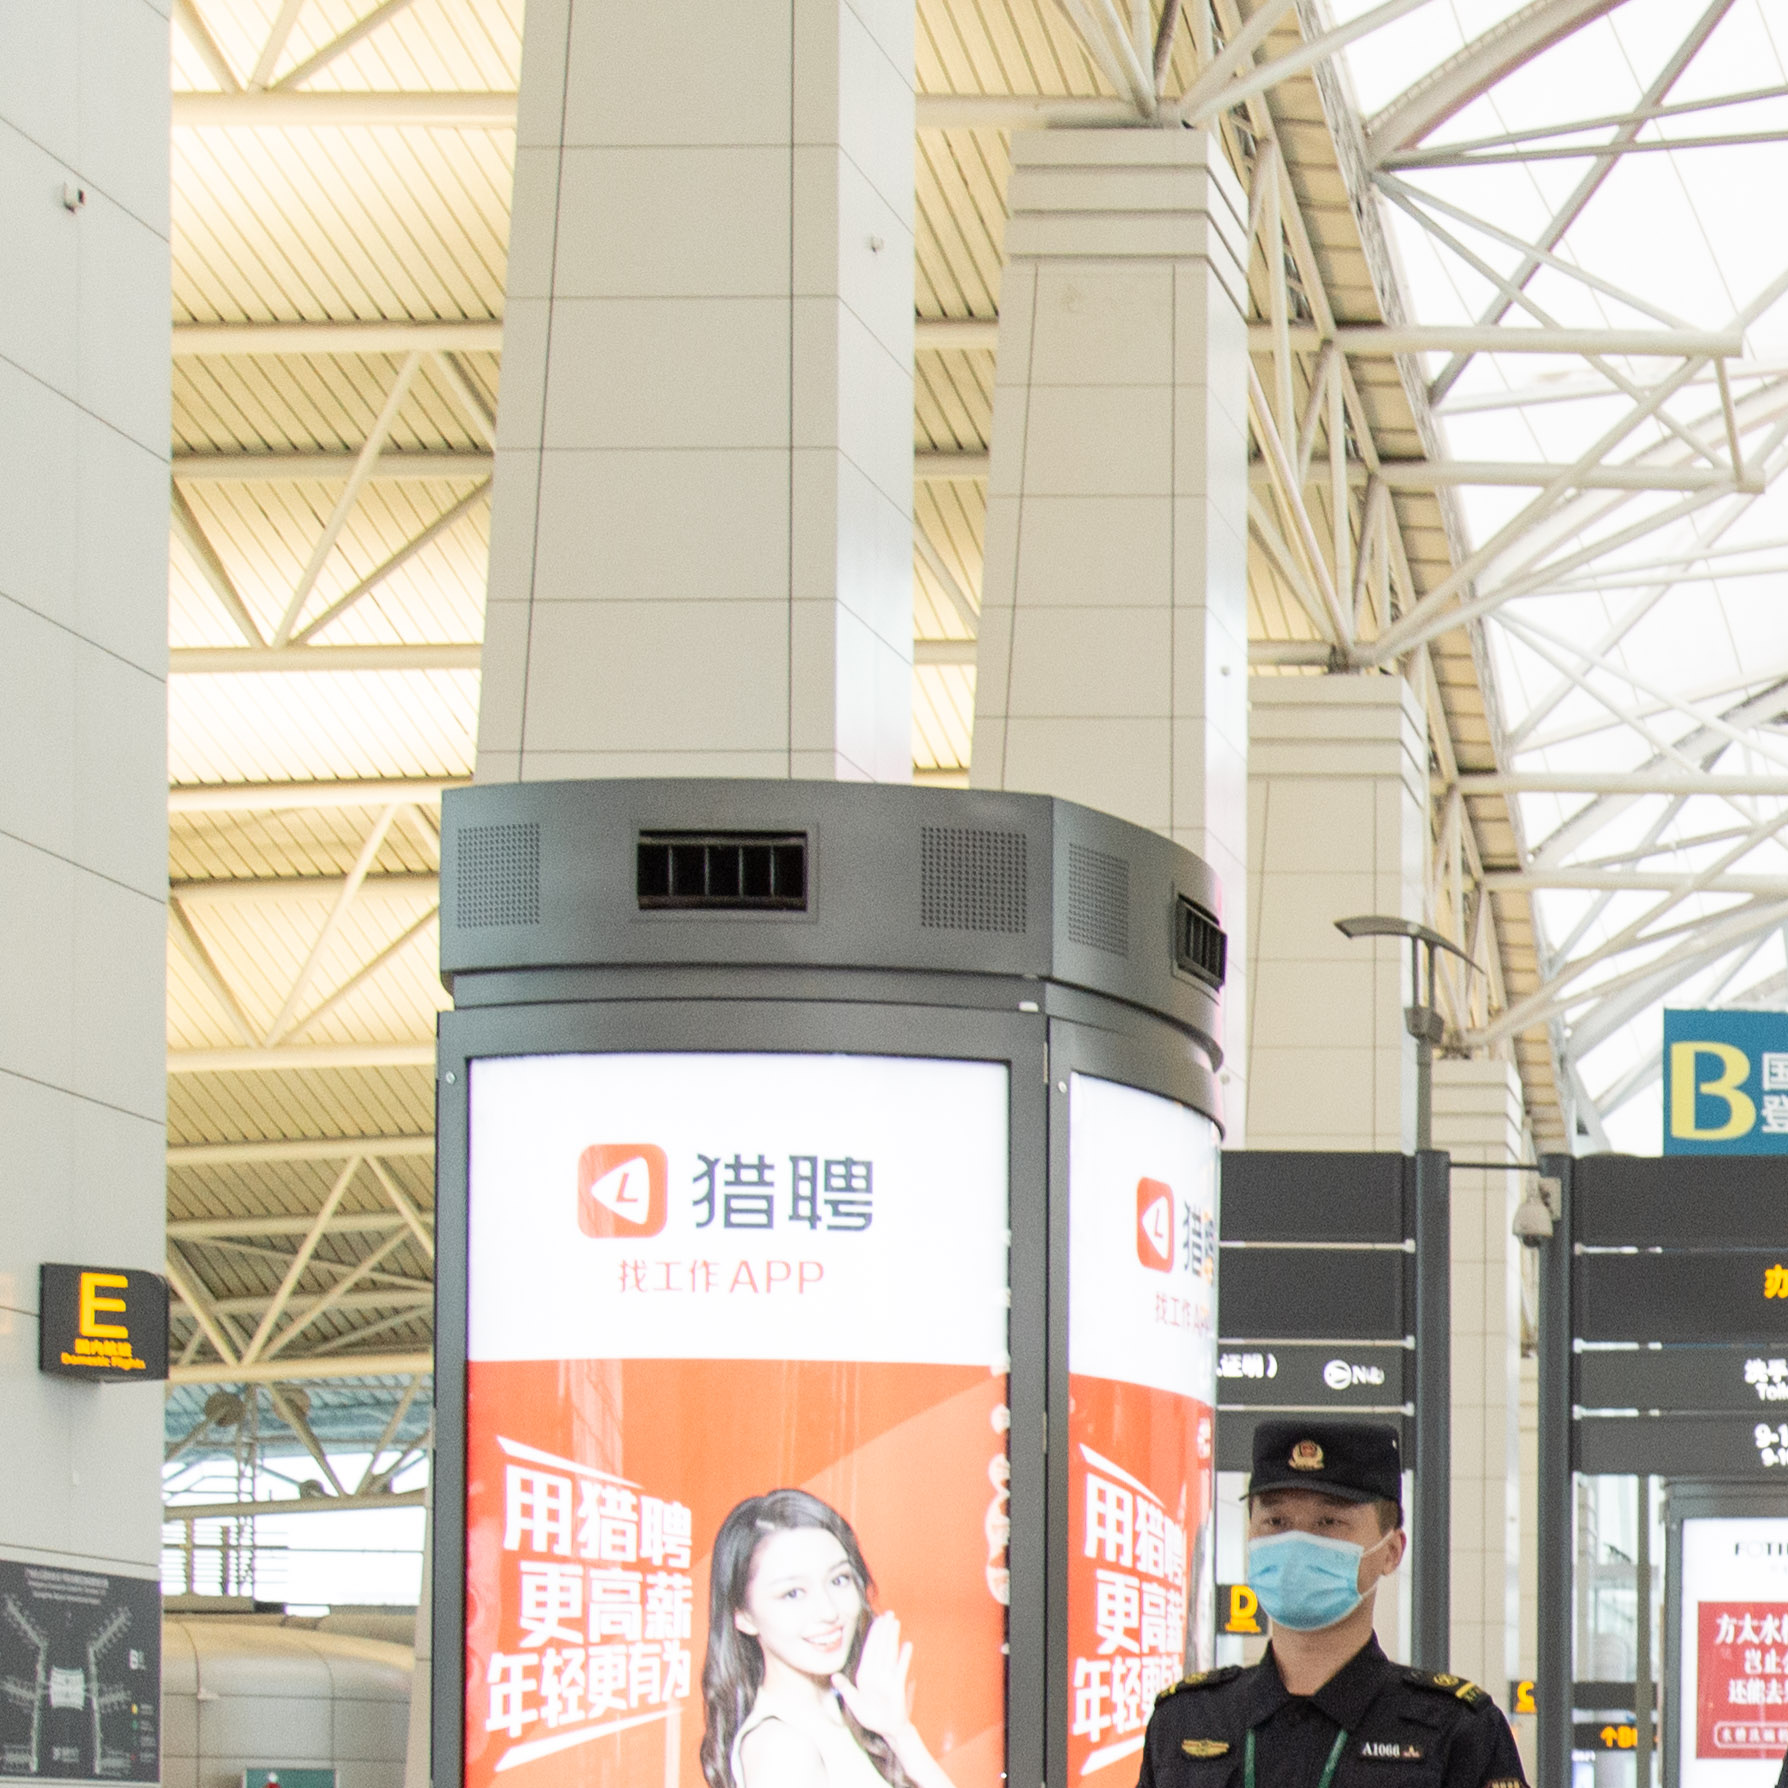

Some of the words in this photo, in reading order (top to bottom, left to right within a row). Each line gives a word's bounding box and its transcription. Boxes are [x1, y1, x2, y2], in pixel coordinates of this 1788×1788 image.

[1670, 1041, 1757, 1142] B
[692, 1153, 873, 1231] 猎聘
[80, 1272, 129, 1339] E
[618, 1258, 720, 1294] 找工作
[729, 1260, 824, 1294] APP
[503, 1464, 693, 1569] 用猎聘
[1084, 1473, 1186, 1583] 用猎聘
[518, 1560, 693, 1649] 更高薪
[1096, 1569, 1184, 1654] 更高薪
[1231, 1585, 1258, 1618] D
[484, 1639, 692, 1738] 年轻更有为
